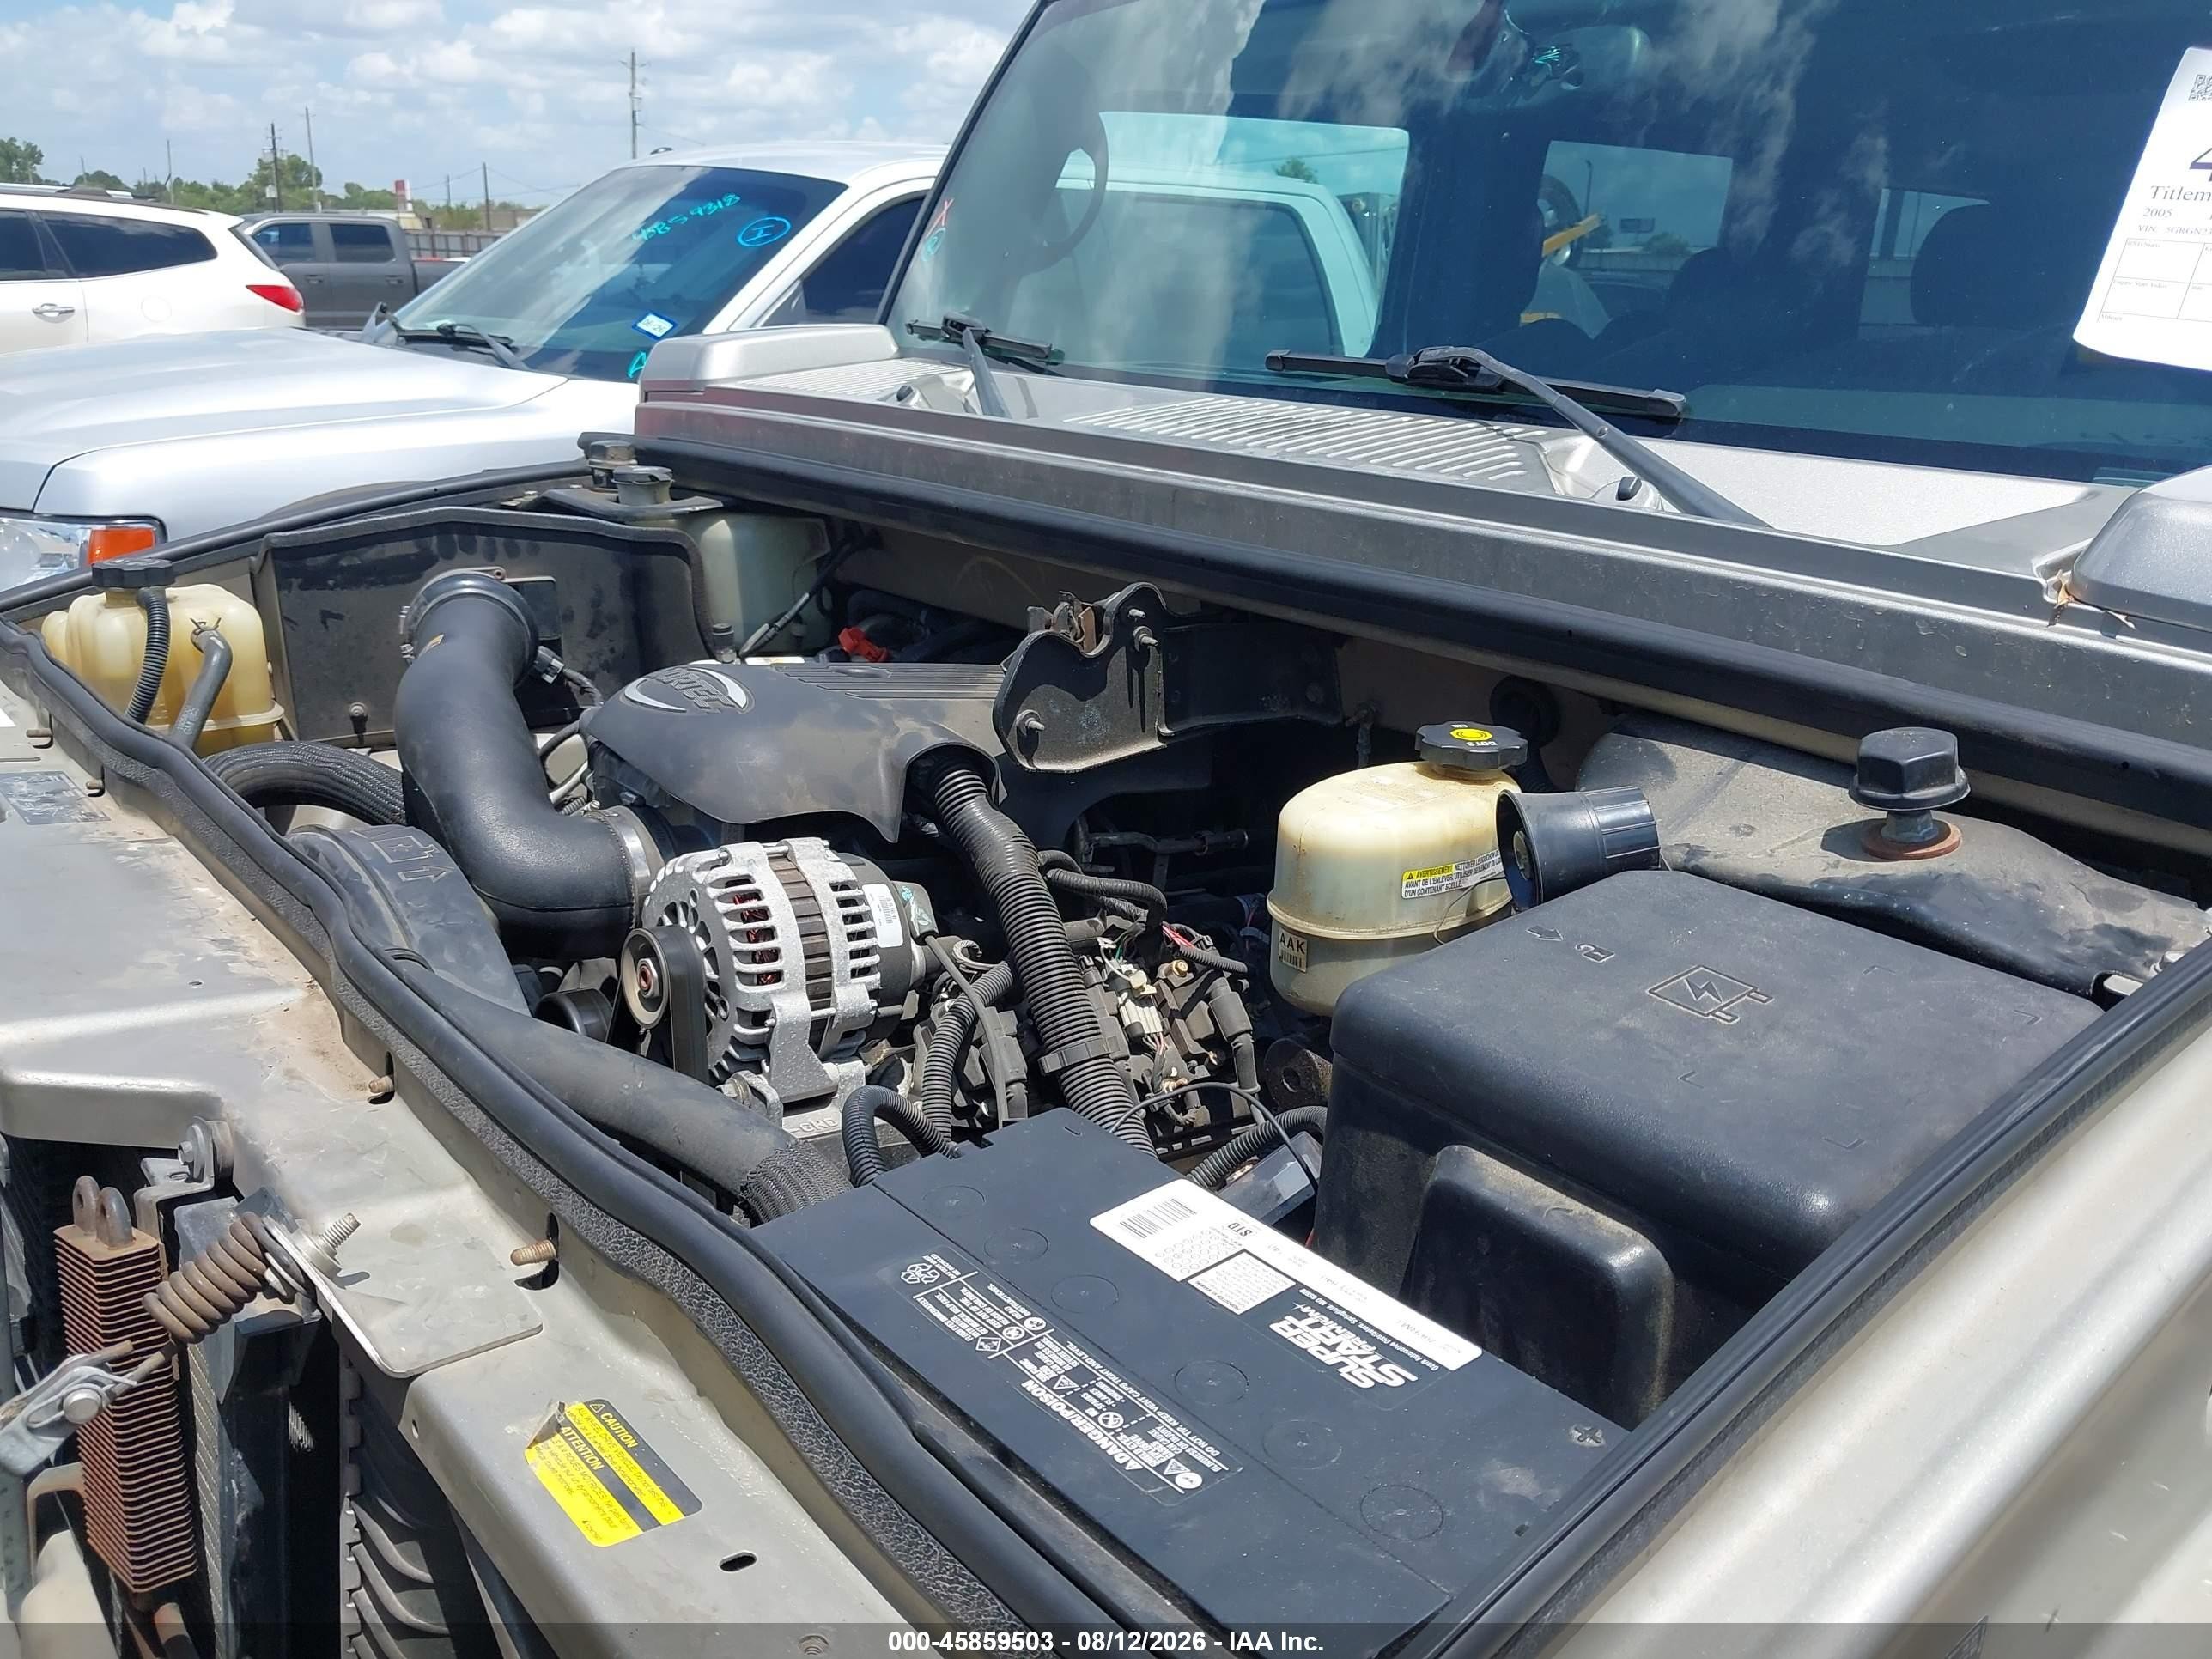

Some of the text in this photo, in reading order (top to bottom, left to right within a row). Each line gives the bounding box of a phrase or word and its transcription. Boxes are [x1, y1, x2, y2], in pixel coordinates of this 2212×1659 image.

[2143, 207, 2173, 219] 2005
[1416, 866, 1453, 879] AVERTISSEMENT
[1405, 879, 1420, 888] AVANT
[1422, 878, 1428, 886] DE
[1405, 889, 1415, 898] D'UN
[1417, 885, 1444, 896] CONTENANT
[1279, 933, 1305, 955] AAK
[1224, 1221, 1254, 1237] STD
[945, 1302, 962, 1314] HELP
[957, 1297, 974, 1306] THE
[975, 1310, 991, 1319] OUT
[988, 1310, 1011, 1325] REACH
[1002, 1305, 1024, 1320] READ
[944, 1320, 960, 1330] EYES
[975, 1325, 989, 1334] GET
[985, 1317, 1003, 1328] KEEP
[1298, 1306, 1377, 1351] PREMIUM
[1032, 1340, 1073, 1370] BLINDNESS OR
[1061, 1340, 1089, 1358] LEVEL.
[1268, 1320, 1387, 1386] SUPER
[1284, 1315, 1419, 1385] START
[1389, 1341, 1423, 1360] Automotive
[1032, 1350, 1066, 1374] CAN CAUSE
[1055, 1350, 1080, 1367] SEVERE
[1083, 1357, 1103, 1370] AND
[1419, 1358, 1440, 1370] Ozark
[1098, 1367, 1122, 1384] TIGHT
[1088, 1387, 1115, 1405] FLAMES
[1093, 1380, 1124, 1401] SMOKING
[1117, 1381, 1142, 1398] CAPS
[1079, 1391, 1106, 1410] SPARKS
[1136, 1395, 1160, 1412] VENT
[1019, 1379, 1133, 1464] DANGER/POISON
[1155, 1409, 1180, 1426] KEEP
[598, 1410, 641, 1449] CAUTION
[557, 1425, 605, 1471] ATTENTION
[1127, 1433, 1168, 1462] EXPLOSIVE
[1146, 1428, 1183, 1454] CAN CAUSE
[1175, 1440, 1190, 1449] OR
[1188, 1434, 1209, 1448] NOT
[1132, 1447, 1161, 1467] SHIELD
[1204, 1445, 1221, 1456] DO
[562, 1451, 584, 1472] ROUES
[1183, 1447, 1222, 1472] BLINDNESS
